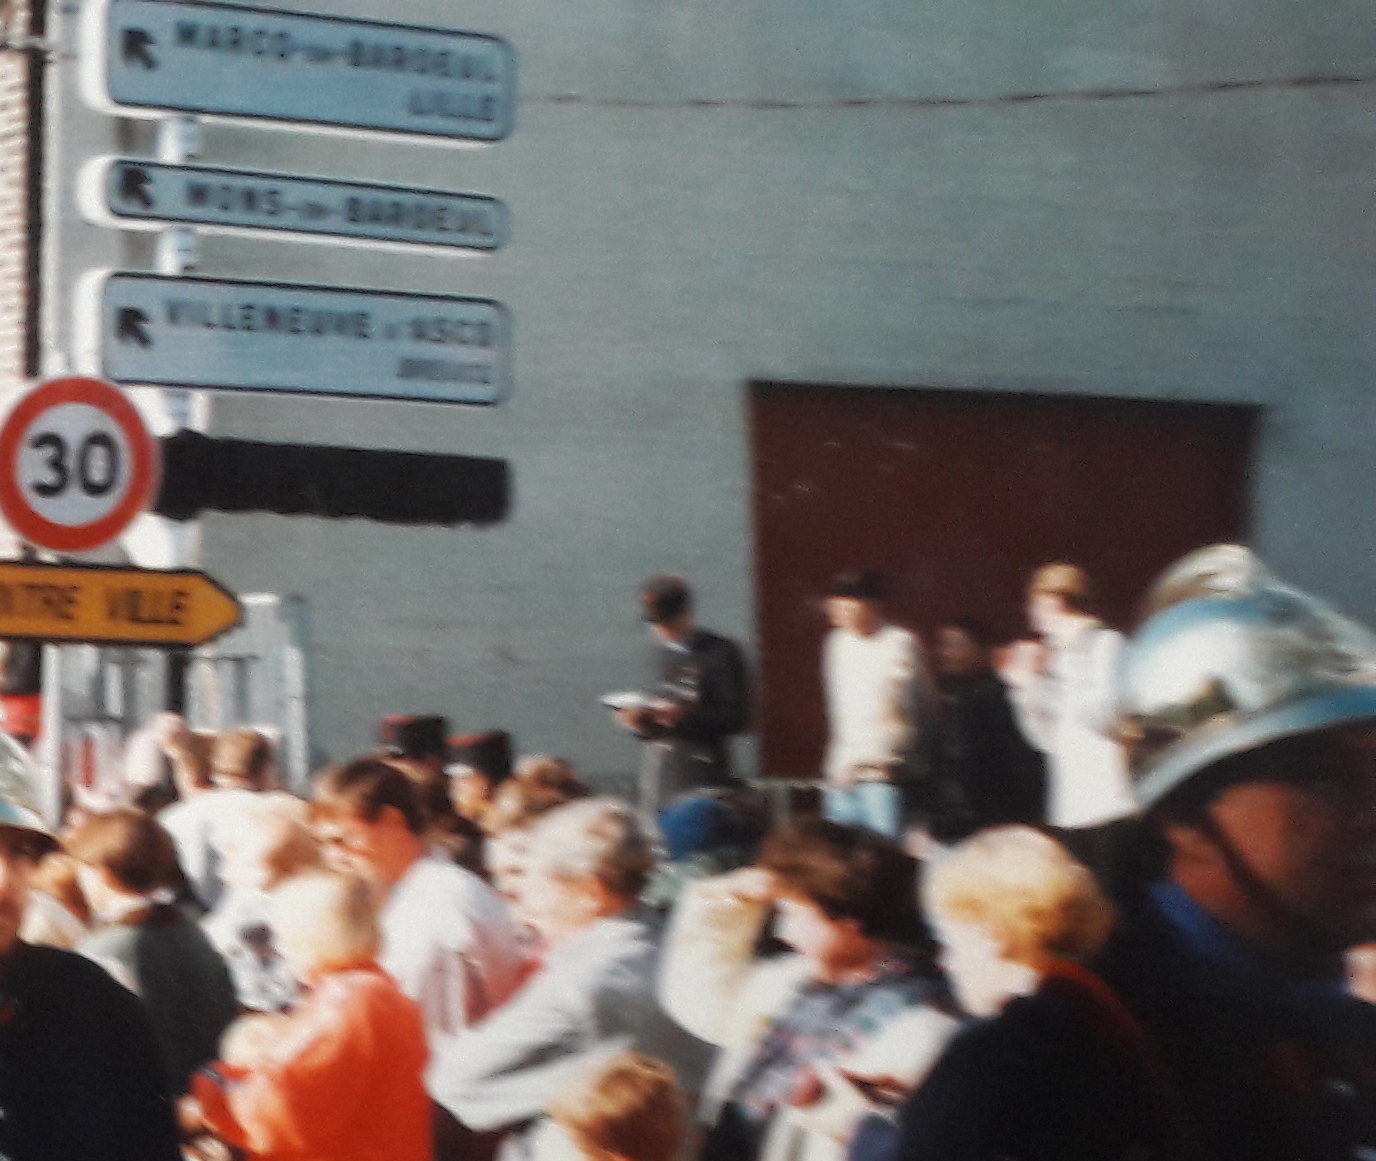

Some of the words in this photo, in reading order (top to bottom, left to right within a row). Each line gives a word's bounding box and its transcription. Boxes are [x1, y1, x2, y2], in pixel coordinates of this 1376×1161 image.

[164, 300, 370, 341] VILLENEUVE
[30, 431, 119, 497] 30
[107, 587, 190, 626] VILLE
